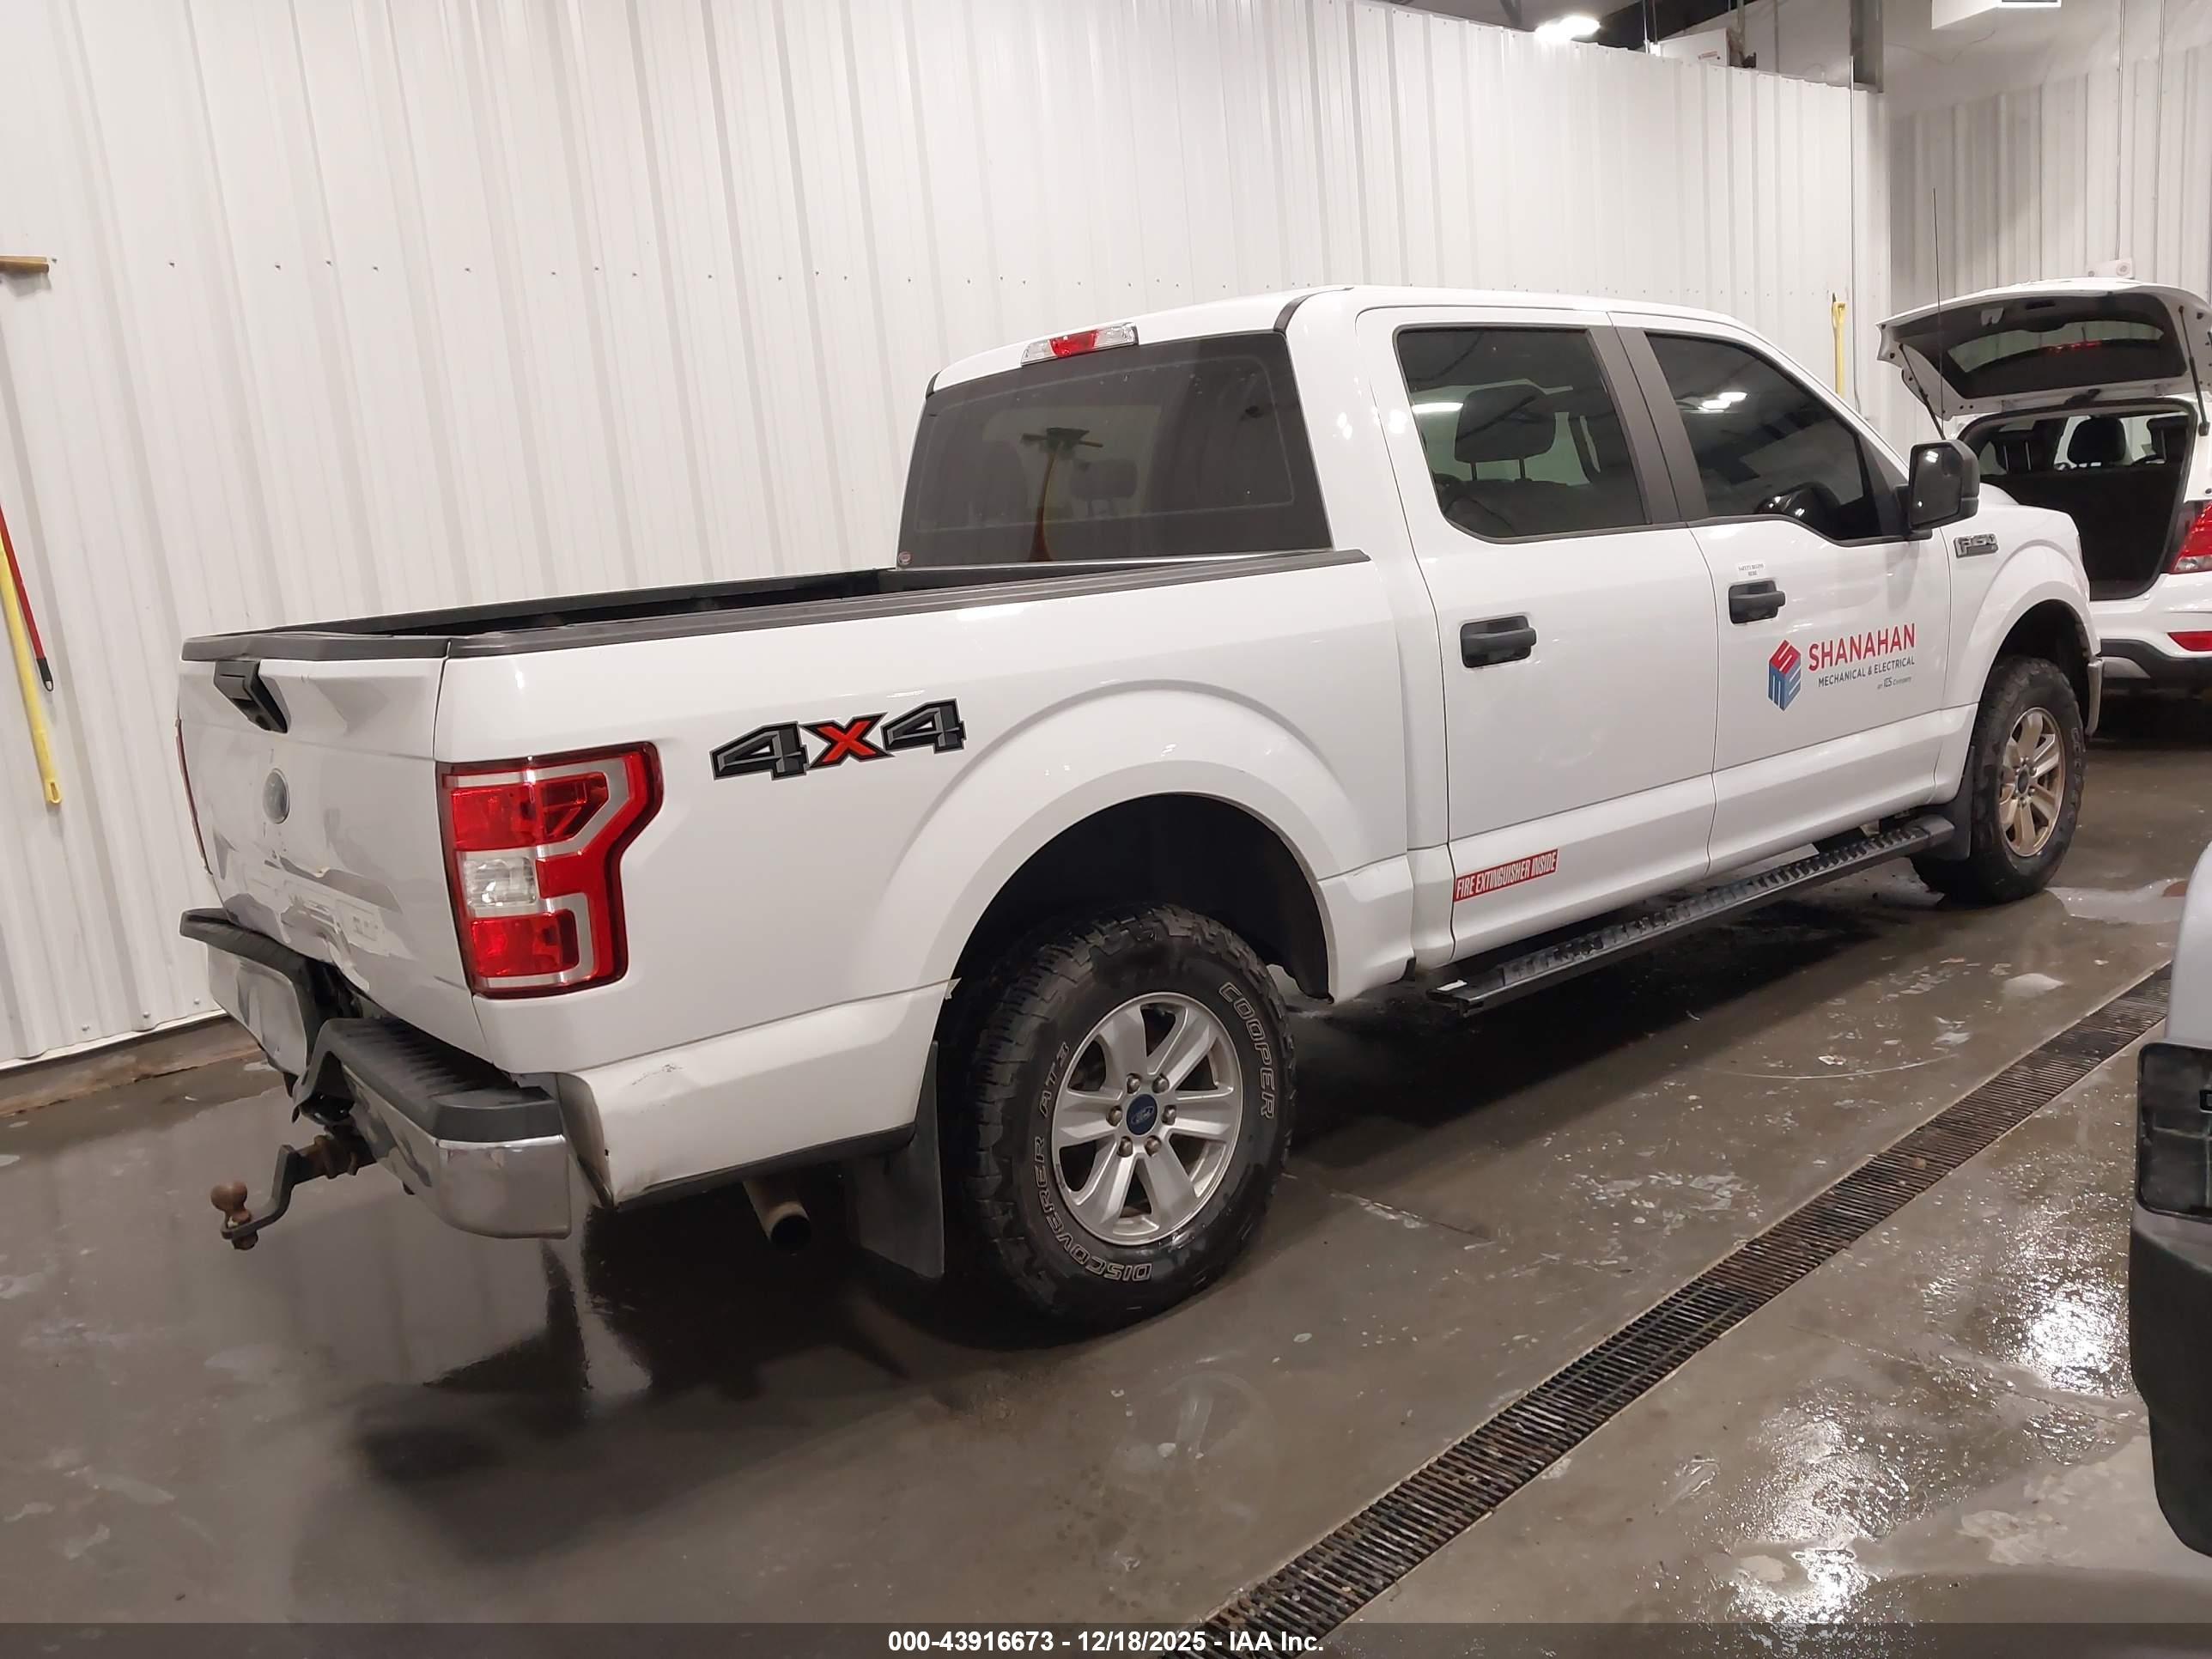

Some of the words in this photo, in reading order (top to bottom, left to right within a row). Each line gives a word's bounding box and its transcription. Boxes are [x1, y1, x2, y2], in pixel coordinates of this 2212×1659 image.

[1808, 623, 1916, 672] SHANAHAN
[1818, 666, 1866, 688] MECHANICAL
[1874, 656, 1915, 674] ELECTRICAL
[1455, 876, 1475, 900] FIRE
[1475, 859, 1531, 894] EXTINGUISHER
[1531, 851, 1557, 877] INSIDE
[1040, 1042, 1070, 1120] AT3
[1218, 981, 1277, 1121] COOPER
[1034, 1135, 1152, 1282] DISCOVERER
